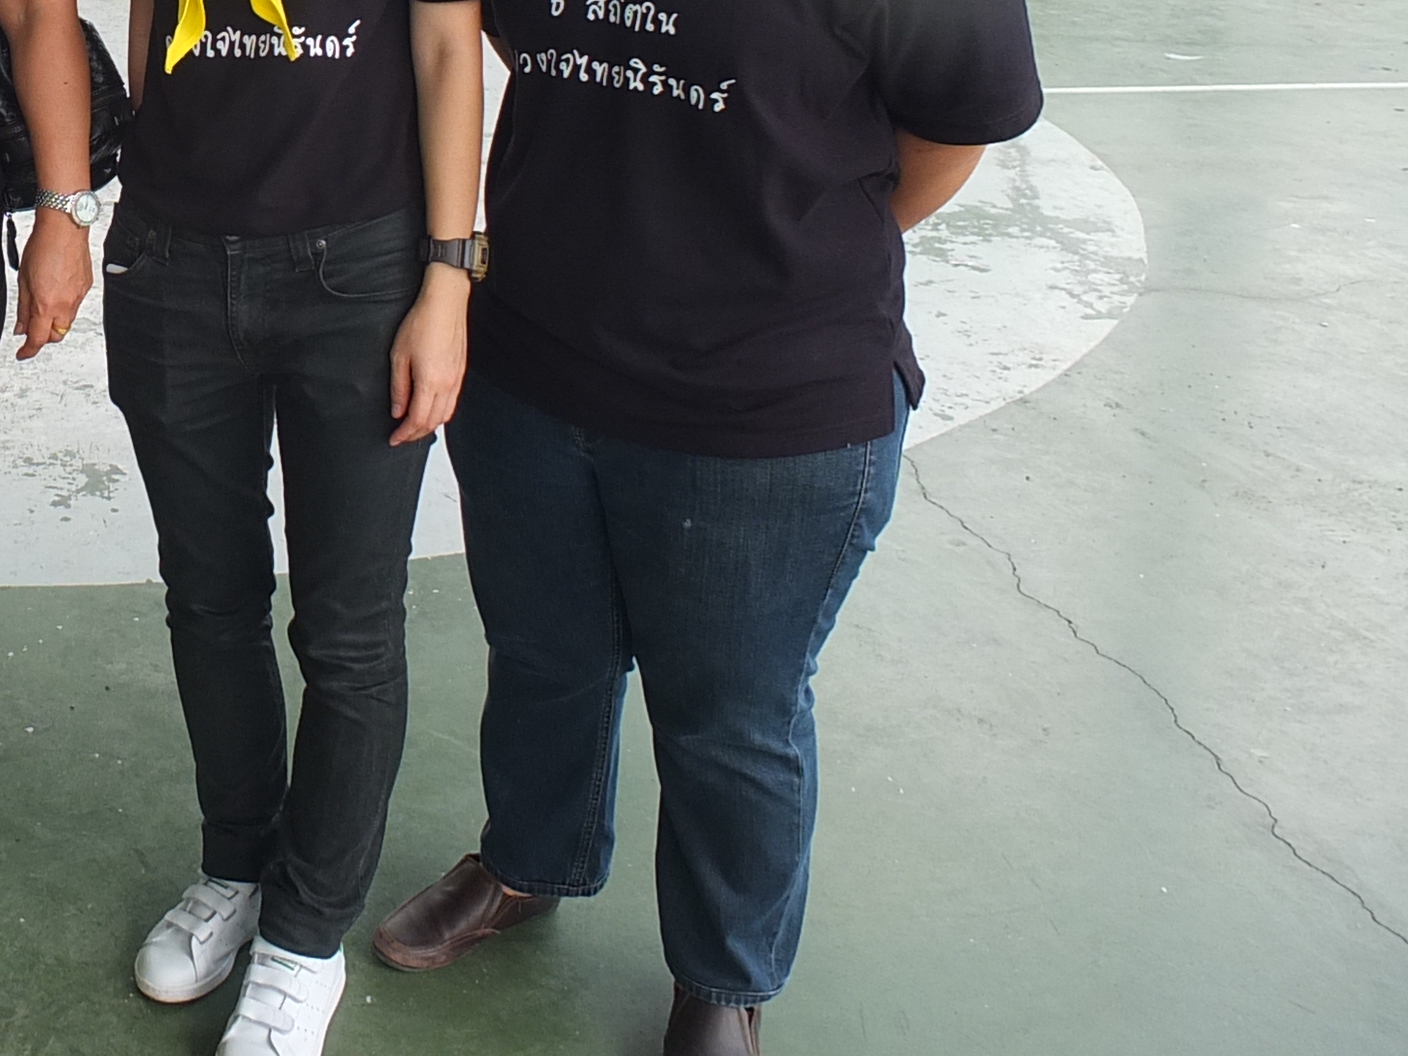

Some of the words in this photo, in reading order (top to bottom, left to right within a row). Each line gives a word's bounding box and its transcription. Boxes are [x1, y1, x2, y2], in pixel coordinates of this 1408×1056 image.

[514, 48, 736, 112] วงใจไทยนิรันดร์
